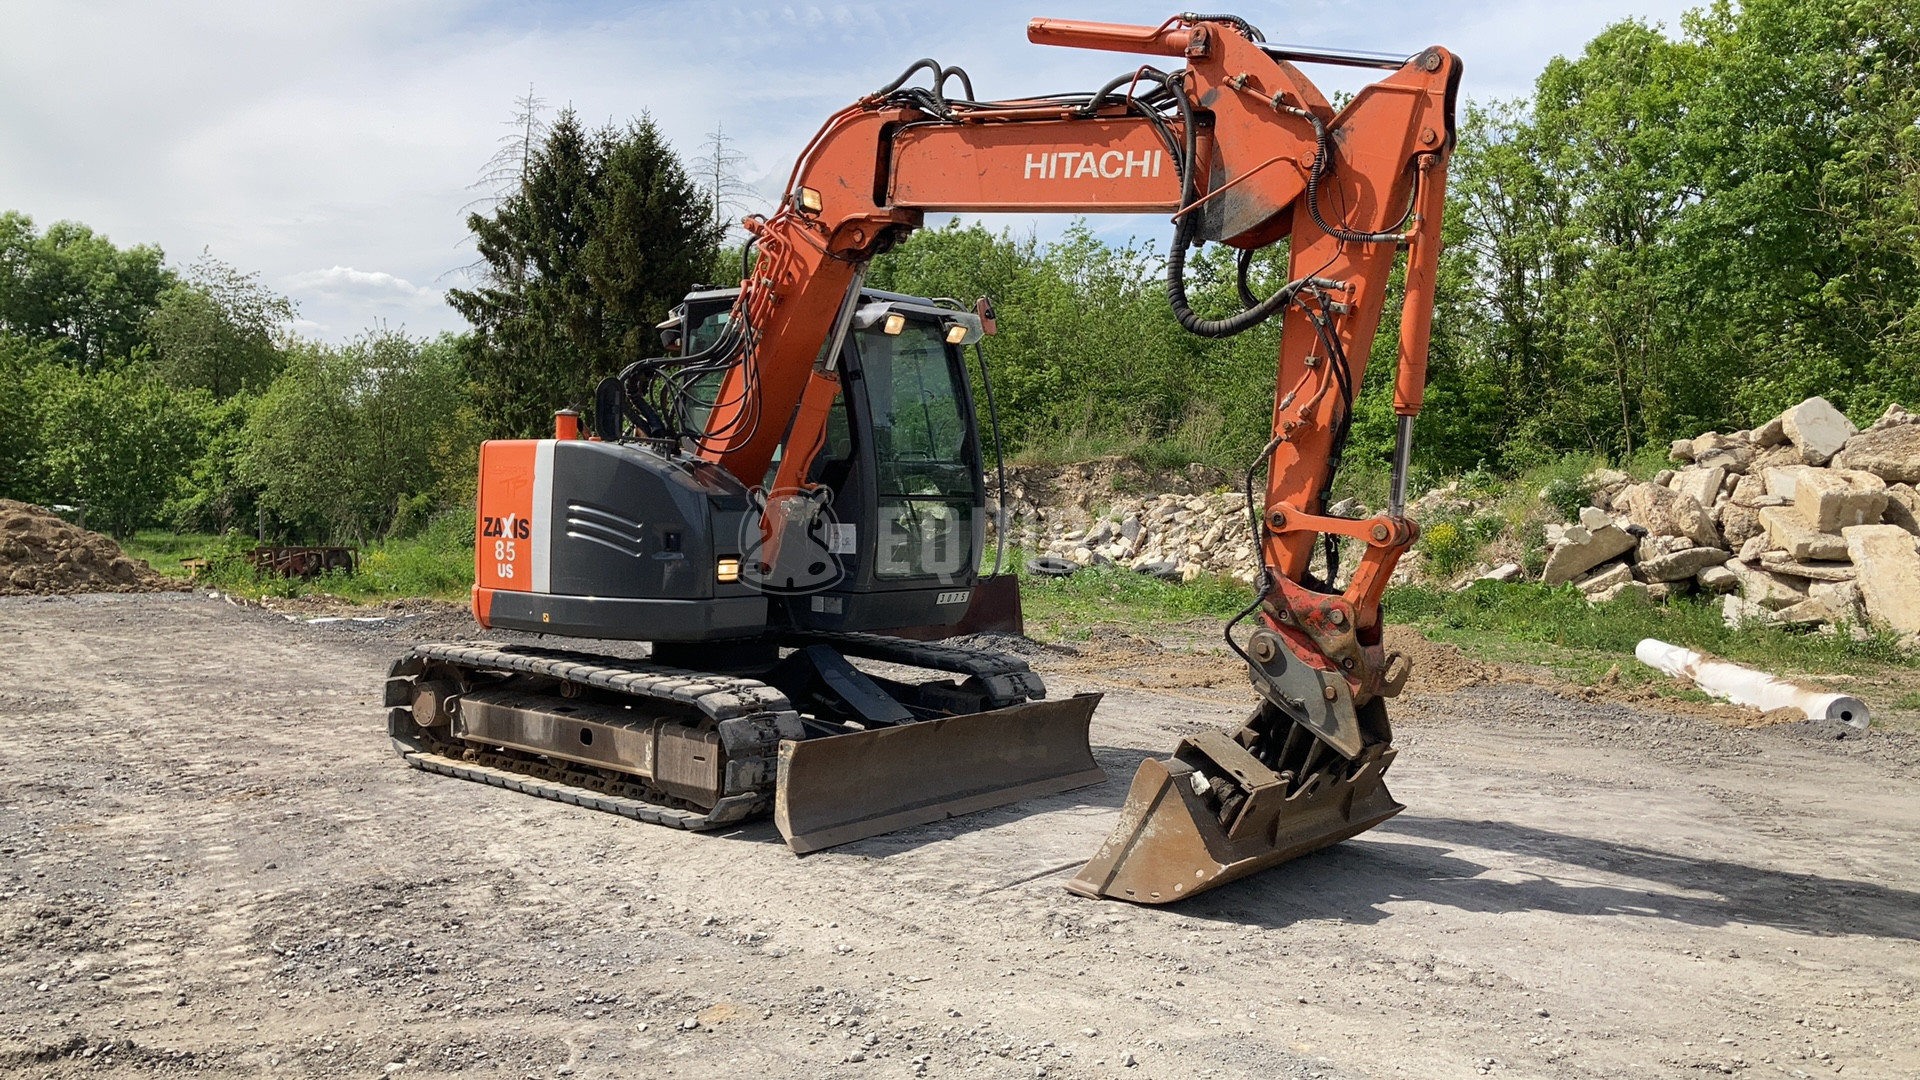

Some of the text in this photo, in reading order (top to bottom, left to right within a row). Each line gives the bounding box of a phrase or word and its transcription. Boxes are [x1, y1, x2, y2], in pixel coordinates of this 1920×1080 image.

[1023, 150, 1162, 180] HITACHI
[483, 512, 530, 540] ZAXIS
[495, 540, 516, 561] 85
[497, 563, 514, 579] US
[939, 592, 966, 603] 3075
